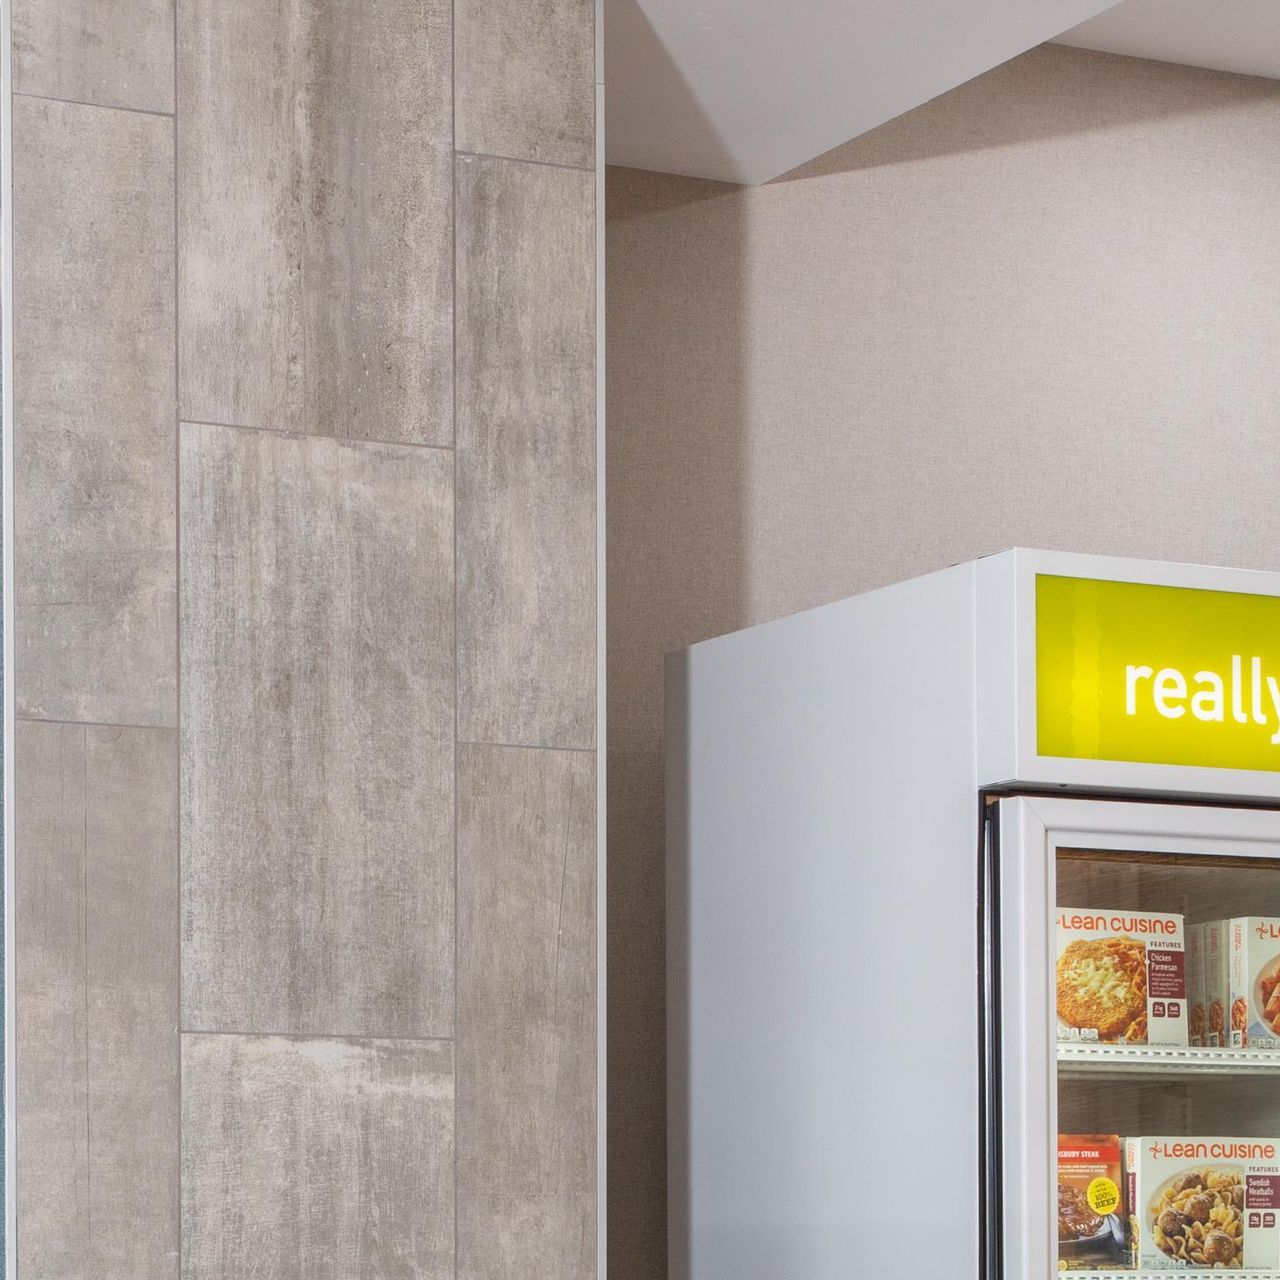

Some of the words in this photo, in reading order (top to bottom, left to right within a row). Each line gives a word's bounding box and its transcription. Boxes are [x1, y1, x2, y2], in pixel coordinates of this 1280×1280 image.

[1062, 915, 1107, 931] Lean
[1110, 917, 1177, 935] cuisine
[1150, 953, 1172, 962] Chicken
[1080, 1150, 1100, 1158] STEAK
[1163, 1143, 1208, 1158] Lean
[1209, 1144, 1275, 1160] cuisine
[1248, 1178, 1271, 1187] Swedish
[1248, 1187, 1274, 1197] Meatballs
